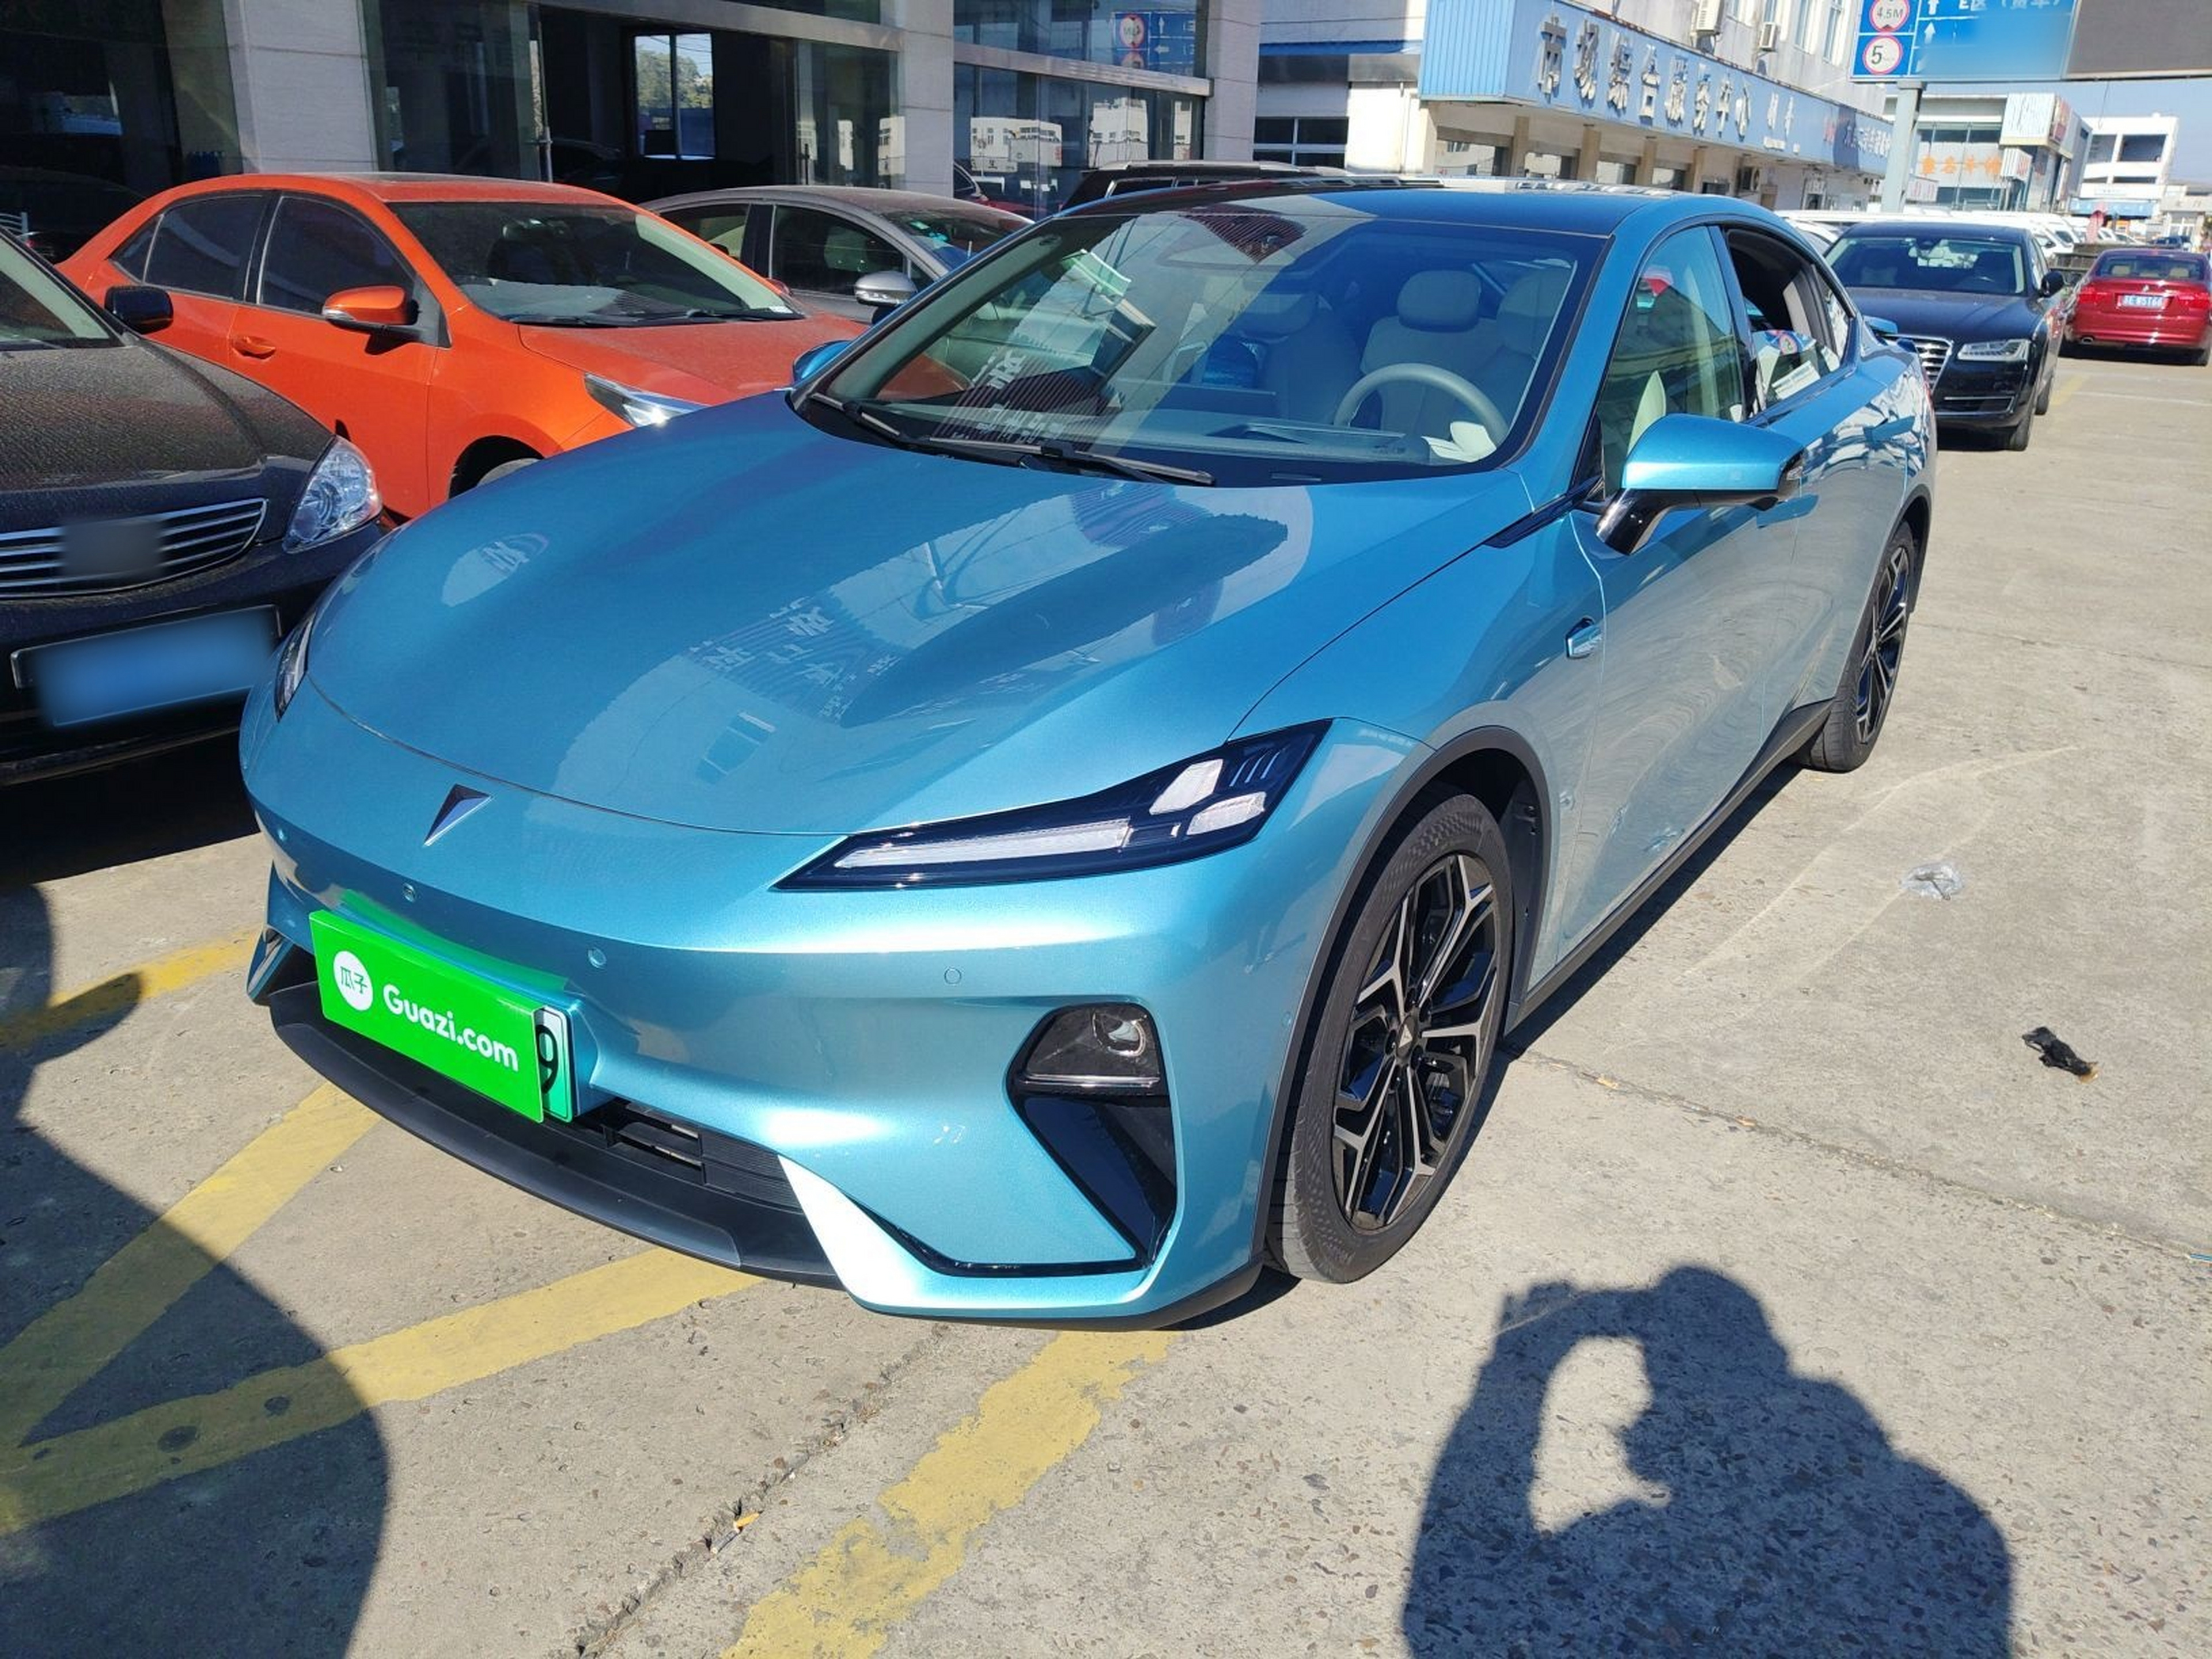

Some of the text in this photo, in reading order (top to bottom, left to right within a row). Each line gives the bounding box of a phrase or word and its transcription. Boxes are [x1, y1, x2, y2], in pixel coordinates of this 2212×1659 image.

[1877, 7, 1903, 18] 4.5M
[1871, 45, 1884, 65] 5
[340, 965, 518, 1072] 瓜子 Guazi.com
